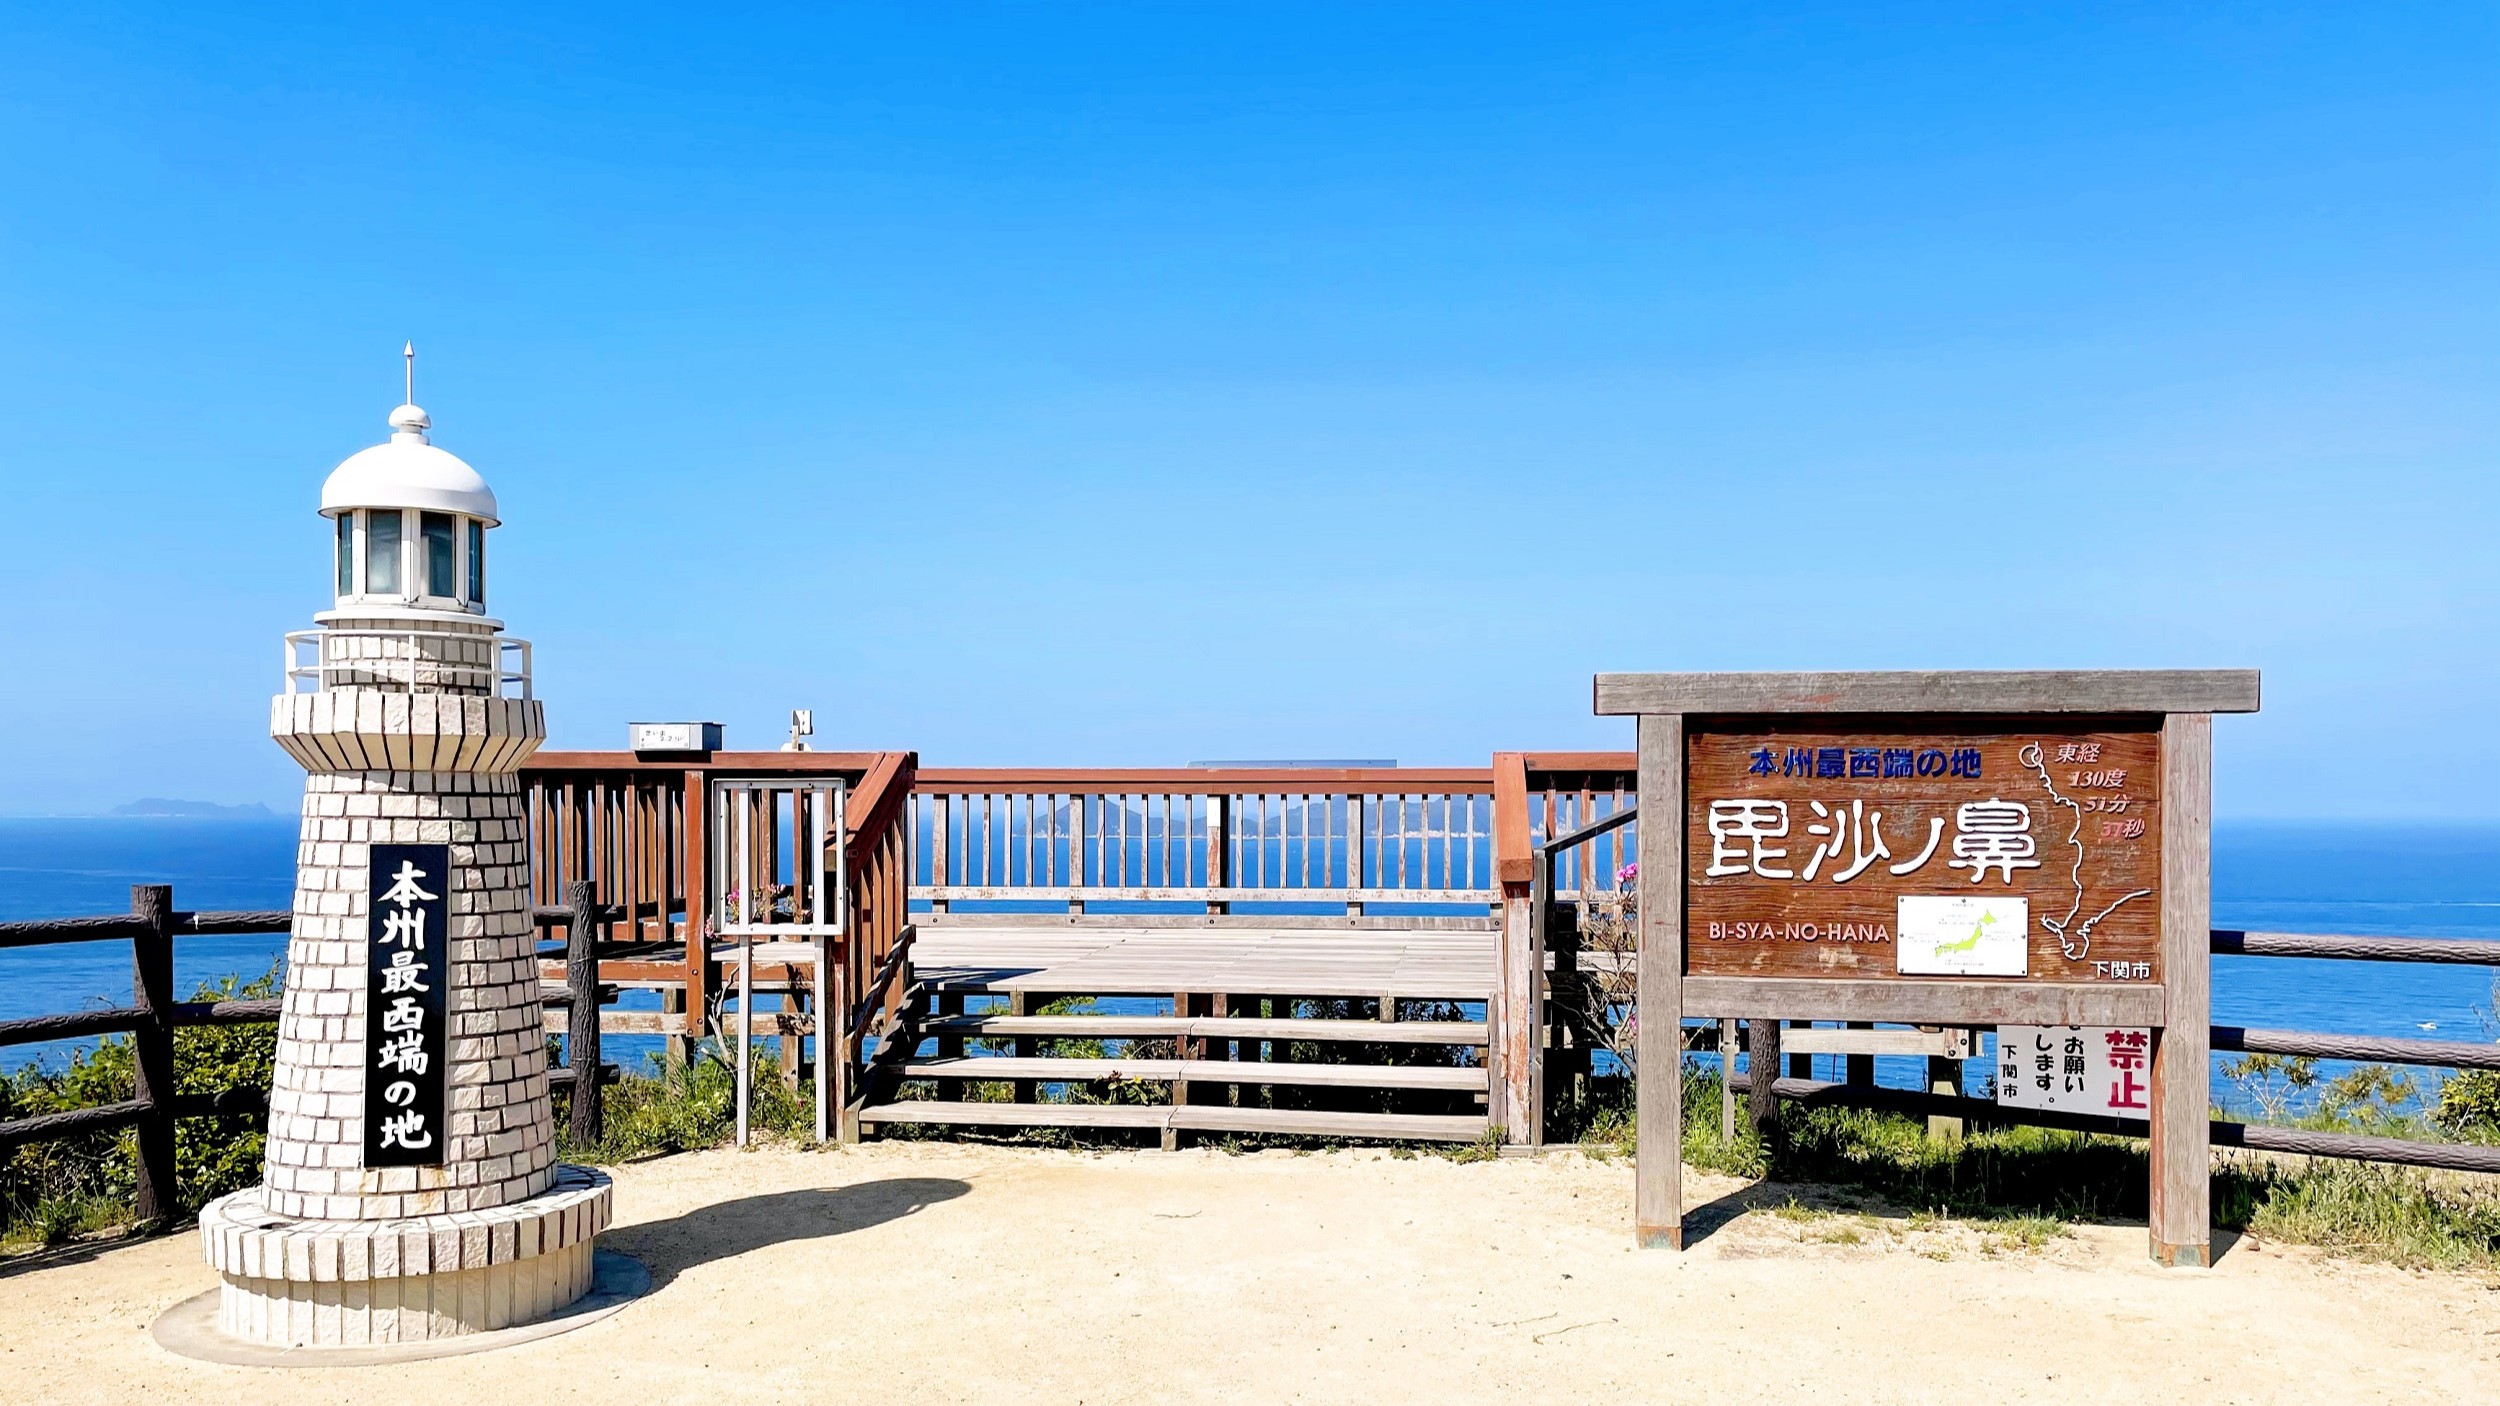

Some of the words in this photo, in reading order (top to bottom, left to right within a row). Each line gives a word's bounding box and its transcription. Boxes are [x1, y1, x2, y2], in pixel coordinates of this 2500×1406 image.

[1749, 747, 1982, 779] 本州最西端の地
[2054, 743, 2101, 763] 東経
[2068, 768, 2128, 788] 130度
[2084, 794, 2132, 813] 51分
[1706, 797, 2041, 883] 毘沙ノ鼻
[2100, 818, 2146, 839] 37秒
[1709, 921, 1891, 942] BI-SYA-NO-HANA
[2089, 960, 2151, 980] 下関市
[378, 860, 439, 1149] 本州最西端の地
[2001, 1044, 2018, 1098] 下関市
[2035, 1025, 2055, 1104] します。
[2063, 1025, 2086, 1093] お願い
[2104, 1030, 2148, 1109] 禁止
